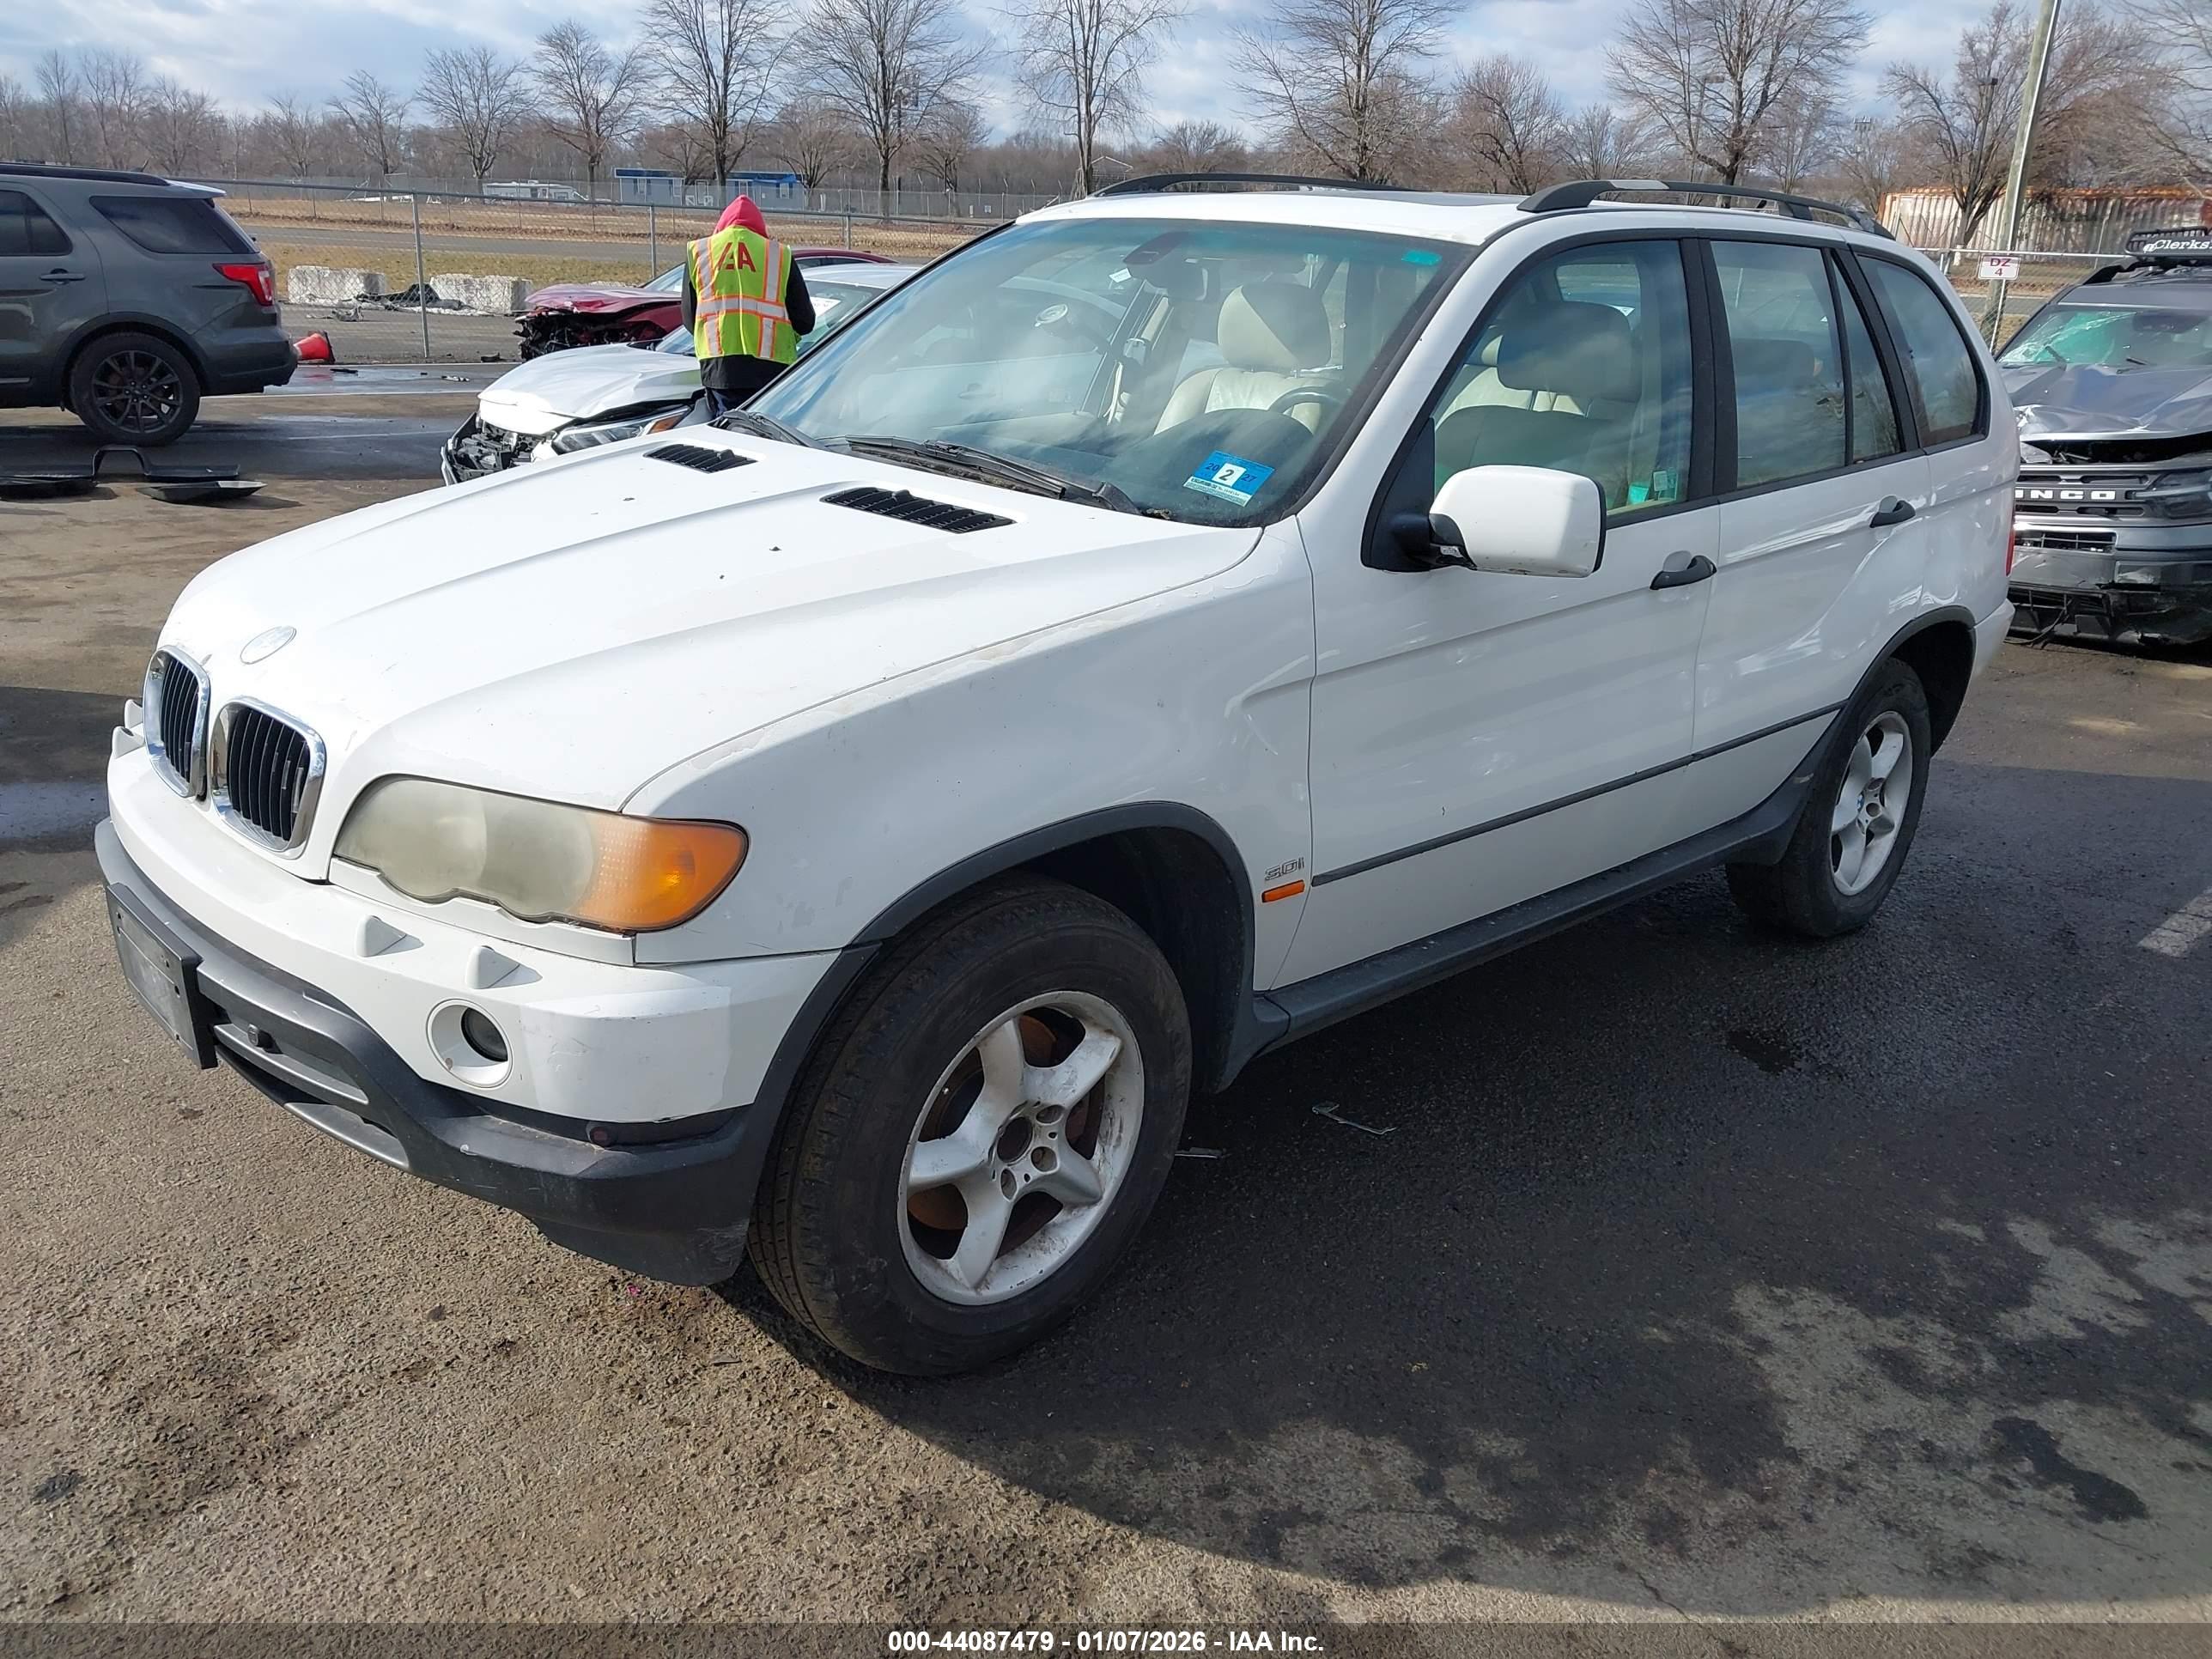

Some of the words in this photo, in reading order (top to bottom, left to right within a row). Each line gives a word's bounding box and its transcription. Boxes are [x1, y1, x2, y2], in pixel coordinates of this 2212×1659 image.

[1990, 258, 2012, 267] DZ
[1994, 268, 2003, 276] 4
[1205, 462, 1220, 471] 20
[1218, 469, 1235, 481] 2
[1241, 473, 1258, 483] 27
